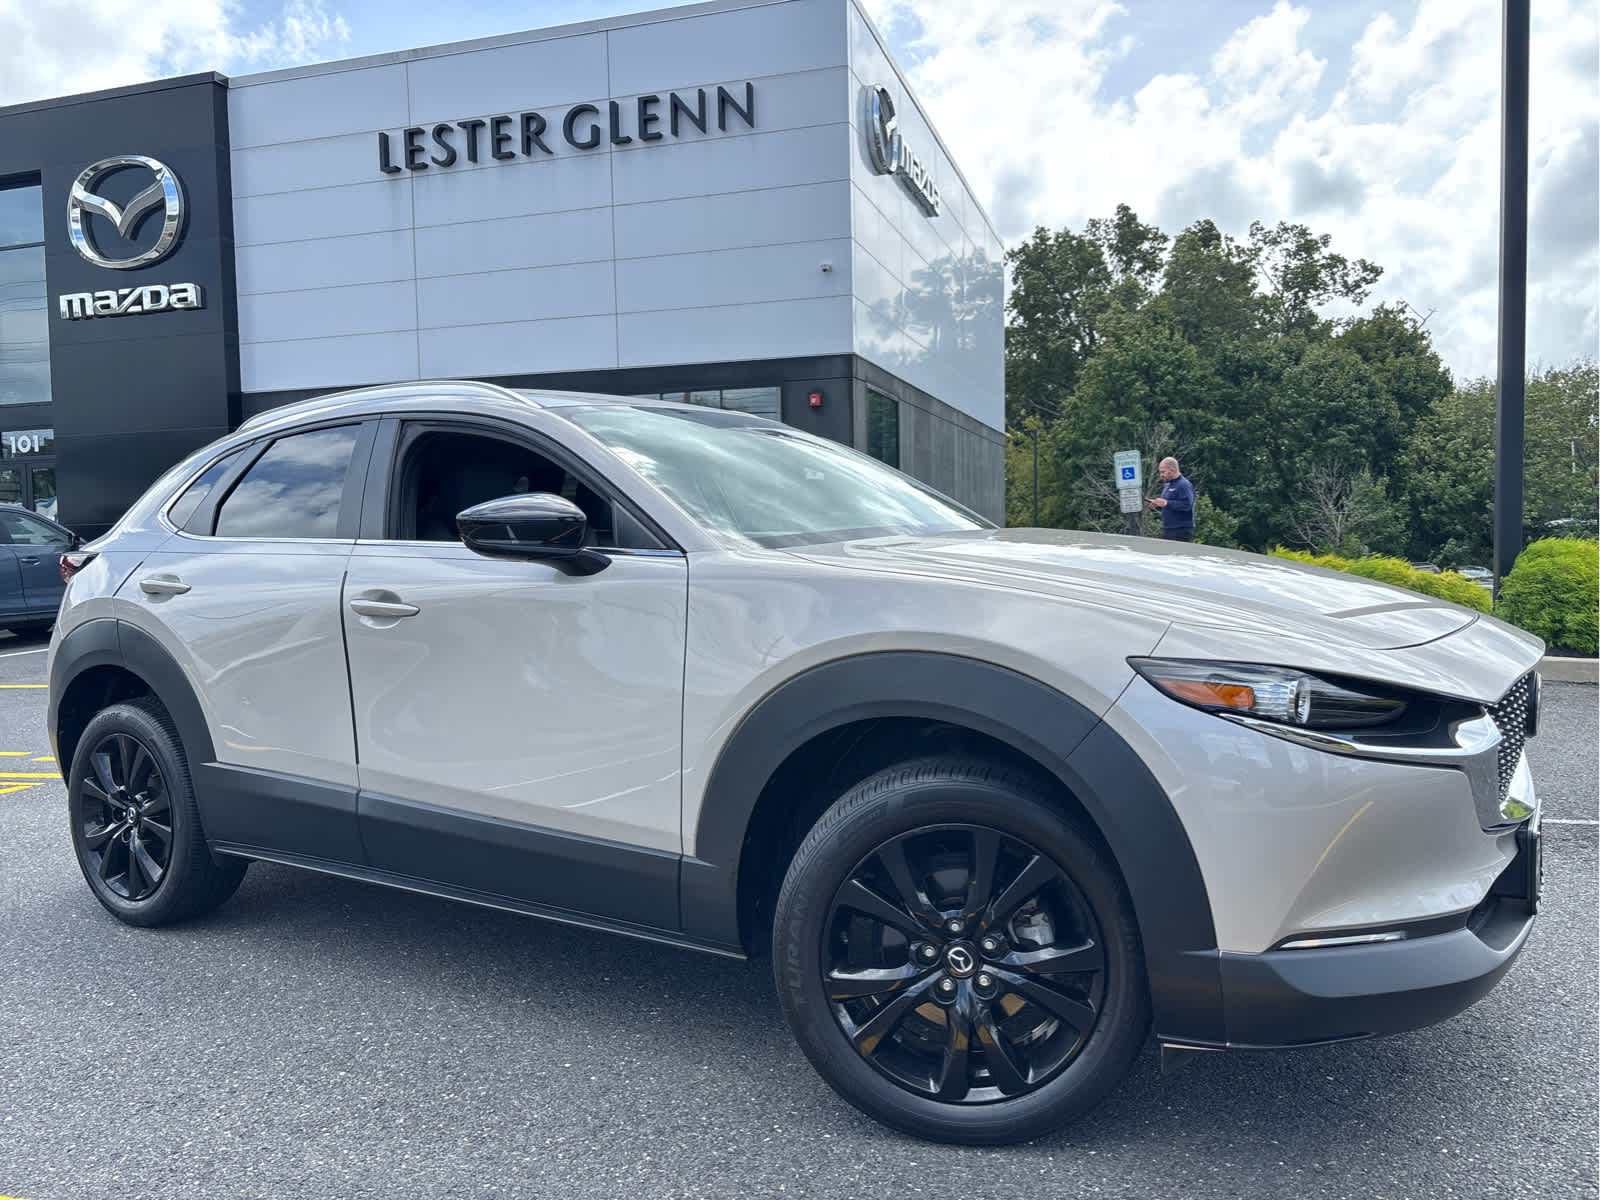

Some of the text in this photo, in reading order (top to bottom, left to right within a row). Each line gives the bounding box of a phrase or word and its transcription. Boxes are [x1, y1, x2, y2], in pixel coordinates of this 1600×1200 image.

[379, 82, 757, 175] LESTER GLENN
[10, 431, 40, 454] 101
